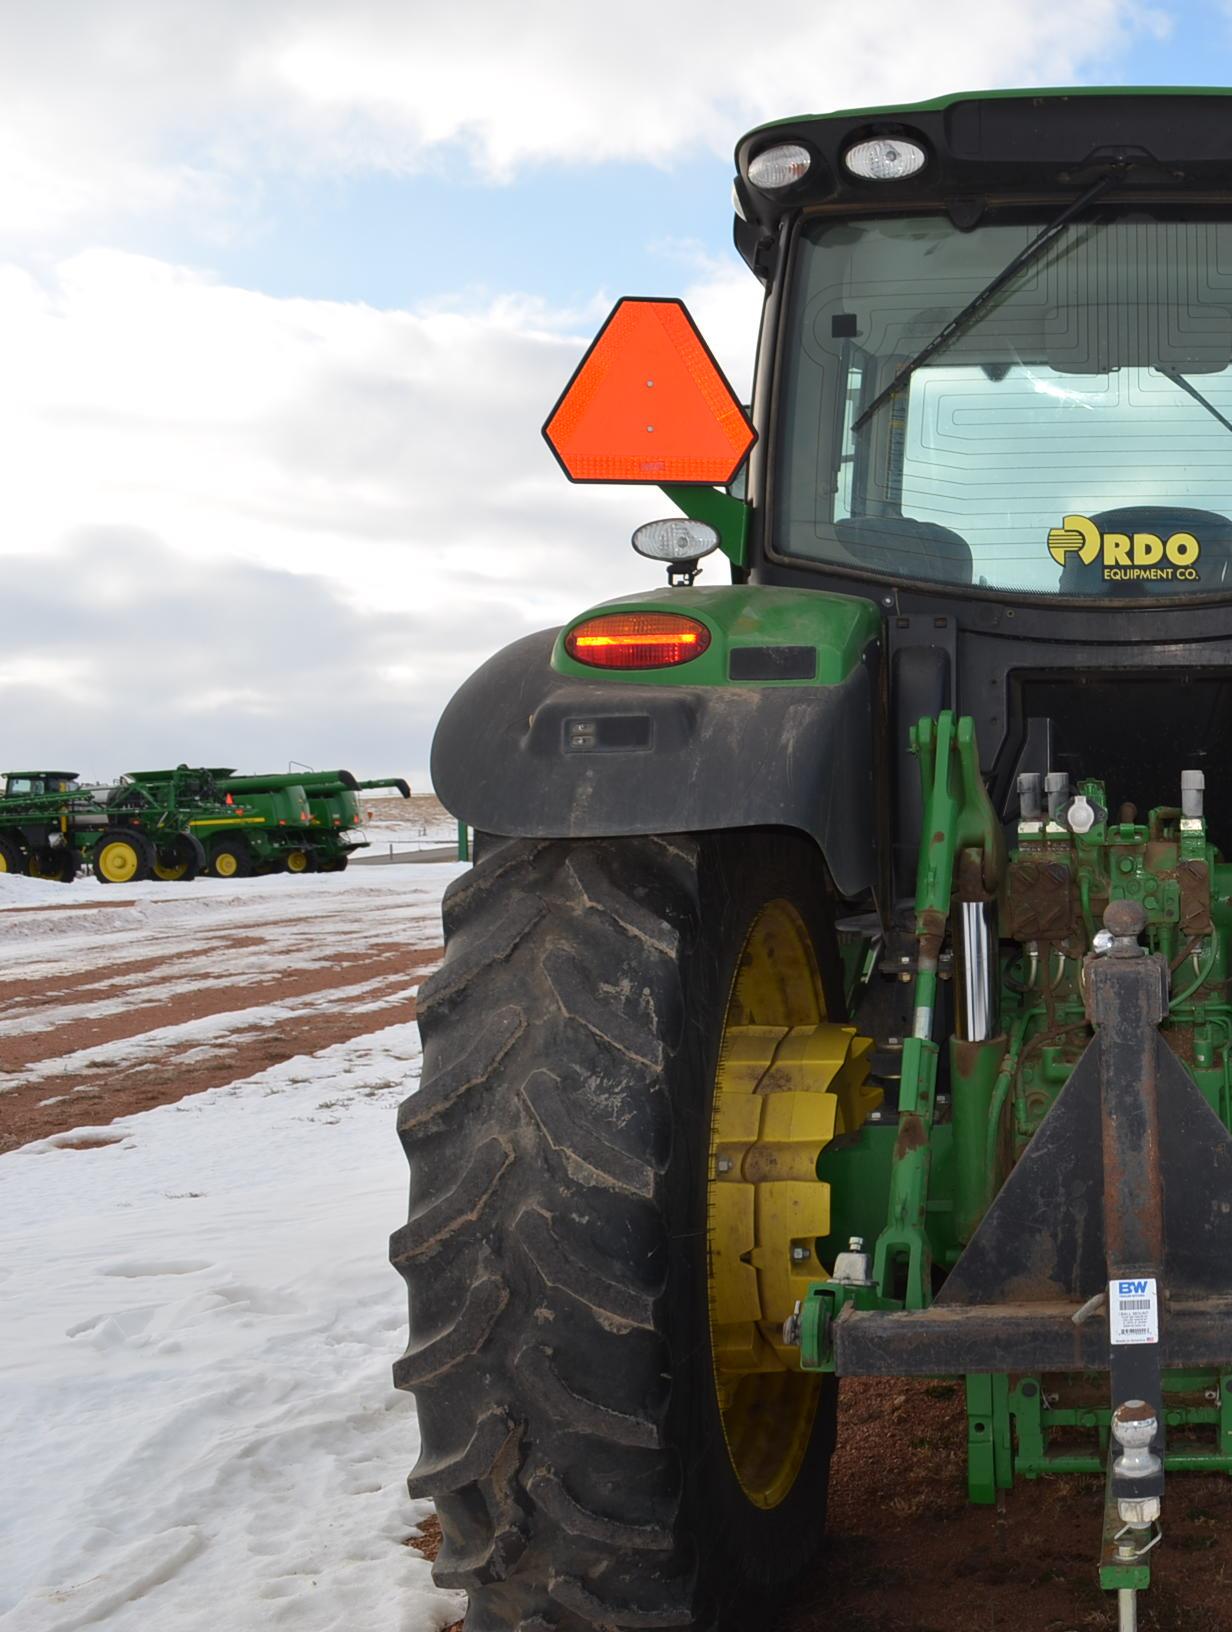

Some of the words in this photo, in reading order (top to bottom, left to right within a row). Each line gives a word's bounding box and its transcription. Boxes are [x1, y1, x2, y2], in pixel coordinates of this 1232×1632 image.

[1103, 533, 1200, 566] RDO
[1104, 568, 1174, 581] EQUIPMENT
[1176, 568, 1200, 580] CO.
